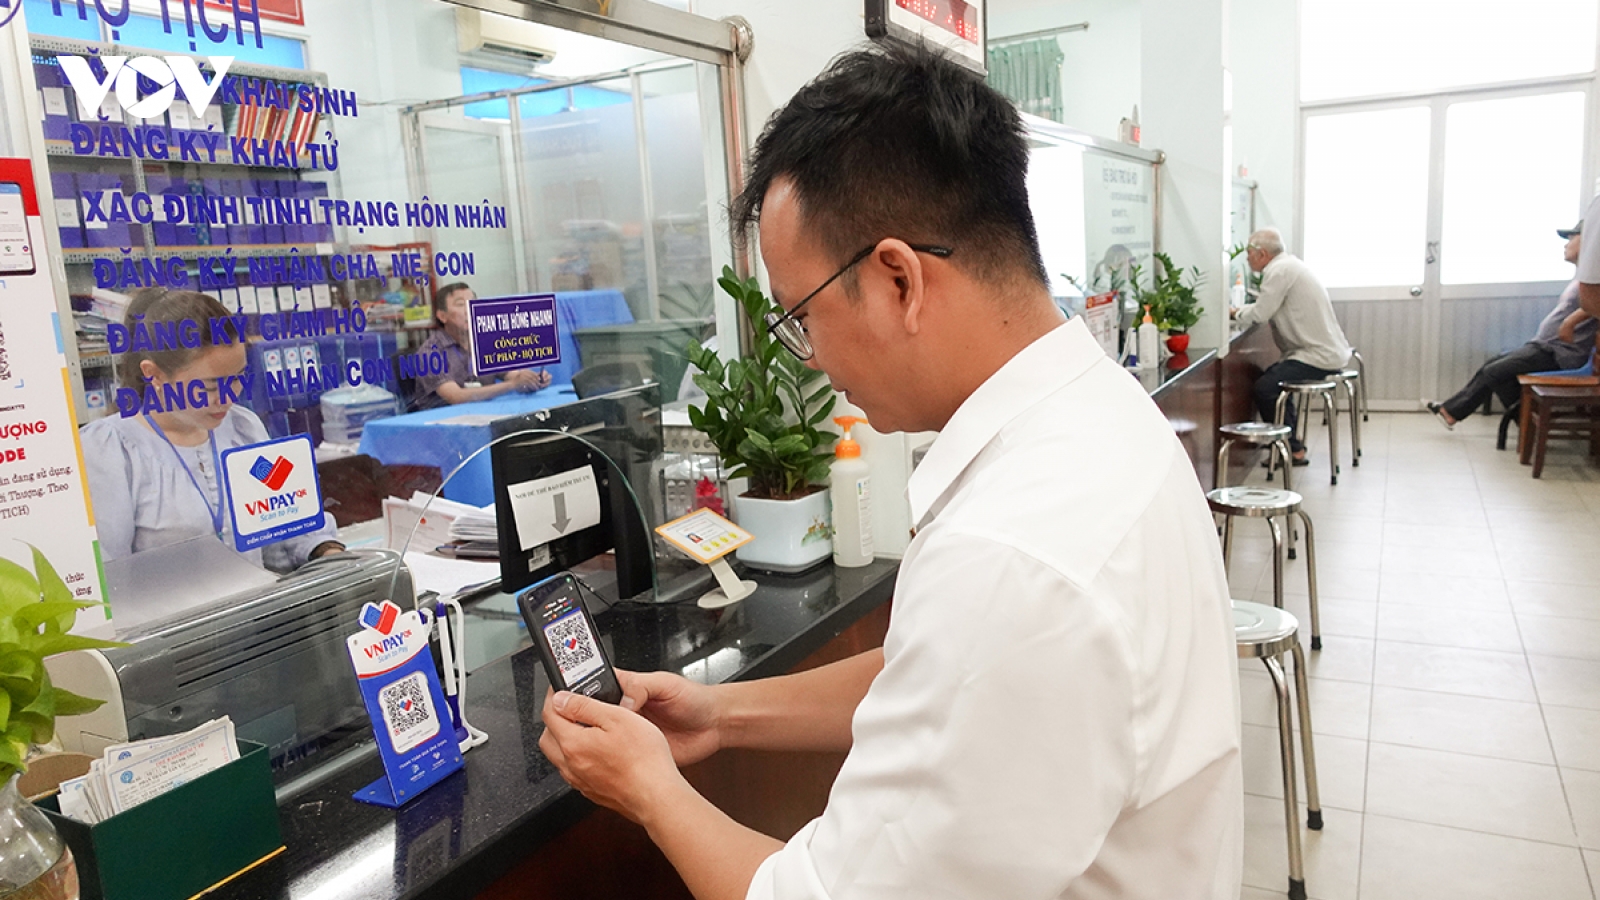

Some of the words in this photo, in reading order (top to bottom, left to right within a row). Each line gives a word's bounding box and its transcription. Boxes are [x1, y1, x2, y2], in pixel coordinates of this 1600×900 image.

[222, 74, 290, 110] KHAI
[298, 85, 358, 117] SINH
[70, 115, 170, 160] ĐĂNG
[179, 125, 219, 163] KÝ
[231, 136, 299, 168] KHAI
[305, 131, 338, 172] TỬ
[83, 183, 154, 224] XÁC
[163, 195, 239, 234] ĐỊNH
[247, 188, 312, 225] TÌNH
[319, 199, 399, 234] TRẠNG
[405, 195, 449, 228] HÔN
[455, 198, 506, 229] NHÂN
[93, 247, 189, 289] ĐĂNG
[199, 249, 237, 285] KÝ
[248, 247, 325, 290] NHẬN
[331, 253, 387, 287] CHA,
[392, 253, 429, 287] MẸ,
[434, 252, 475, 277] CON
[107, 314, 199, 354] ĐĂNG
[209, 306, 249, 345] KÝ
[259, 303, 327, 341] GIÁM
[332, 301, 367, 340] HỘ
[476, 315, 496, 333] PHAN
[496, 313, 510, 334] THỊ
[529, 309, 553, 327] NHANH
[494, 336, 517, 349] CÔNG
[496, 349, 517, 363] PHÁP
[535, 346, 553, 358] TỊCH
[117, 376, 208, 419] ĐĂNG
[217, 364, 256, 402] KÝ
[266, 359, 340, 400] NHẬN
[346, 357, 393, 388] CON
[400, 345, 449, 378] NUÔI
[12, 473, 35, 484] đang
[47, 483, 69, 494] Theo
[260, 510, 277, 522] Scan
[278, 510, 286, 518] to
[287, 506, 299, 516] Pay
